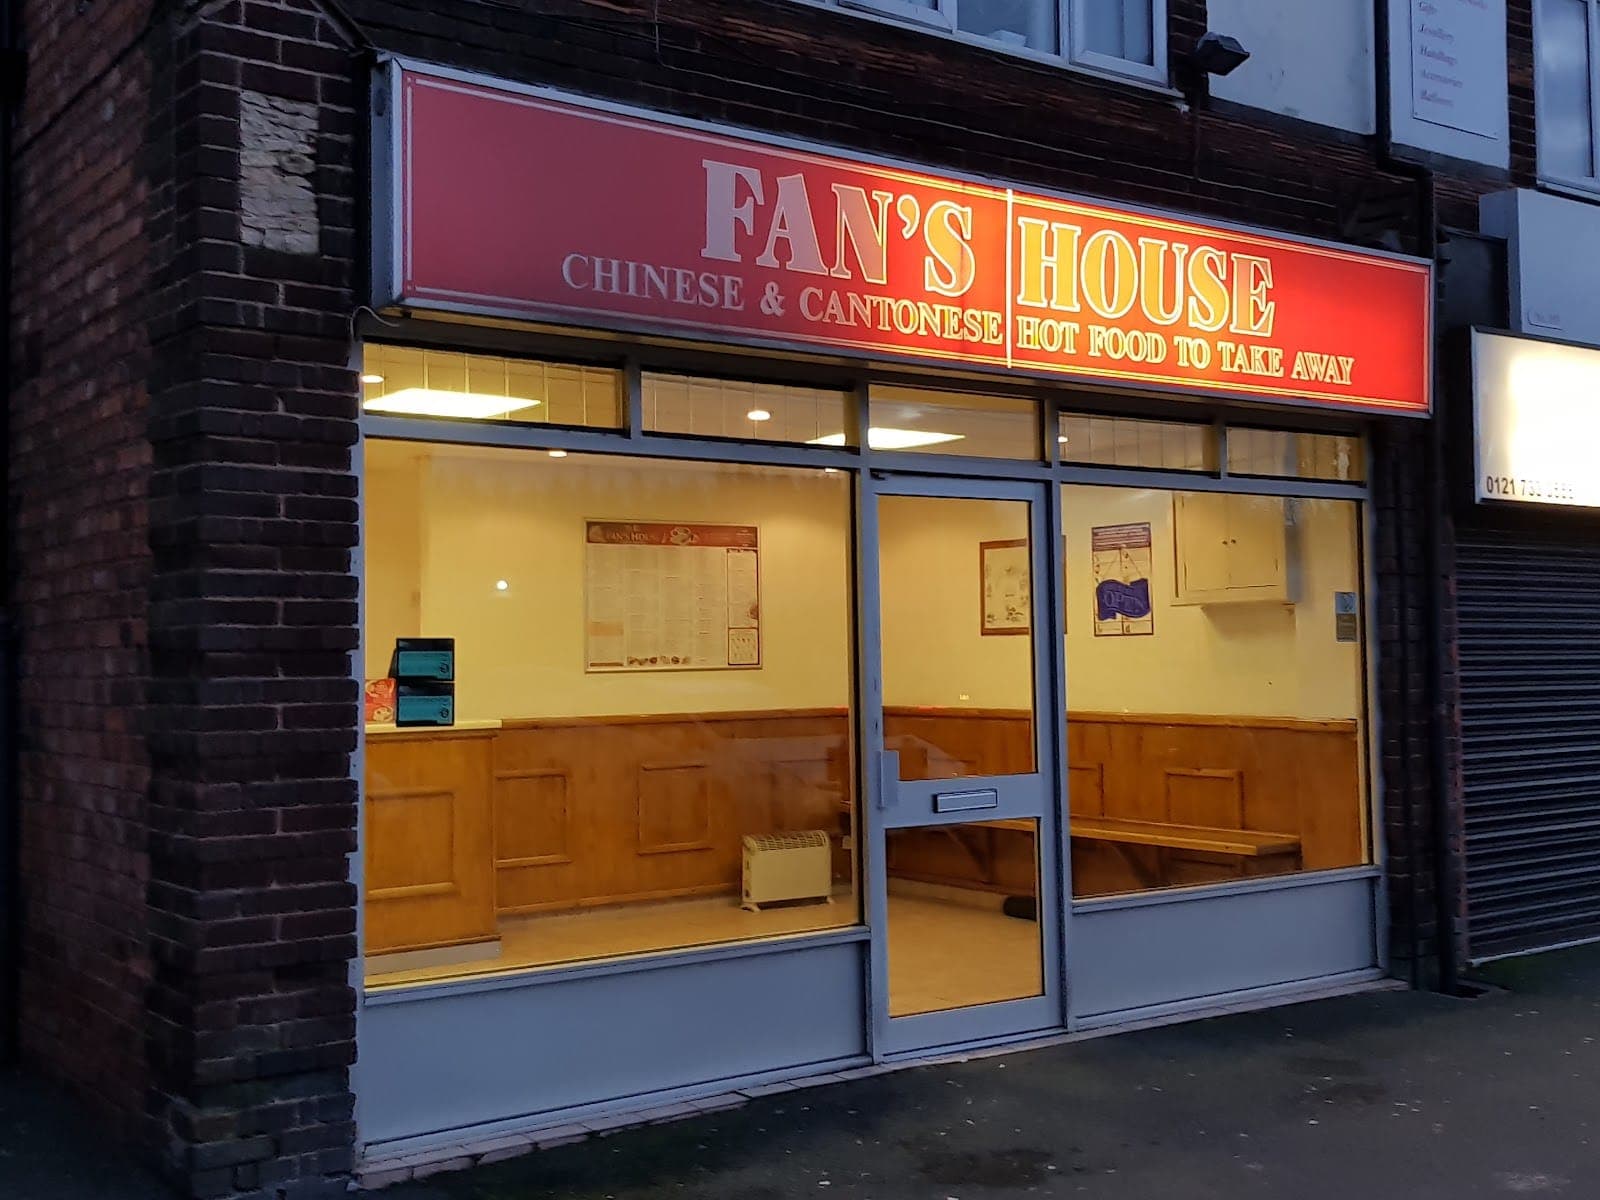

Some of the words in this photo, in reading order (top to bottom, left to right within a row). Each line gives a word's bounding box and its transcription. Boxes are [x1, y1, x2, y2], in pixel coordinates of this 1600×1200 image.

[701, 159, 975, 297] FAN'S
[1017, 217, 1273, 337] HOUSE
[562, 253, 744, 309] CHINESE
[760, 281, 785, 316] &
[799, 286, 1003, 346] CANTONESE
[1016, 315, 1079, 355] HOT
[1088, 325, 1167, 364] FOOD
[1174, 336, 1212, 370] TO
[1216, 341, 1284, 378] TAKE
[1292, 352, 1355, 386] AWAY
[1486, 476, 1516, 495] 0121
